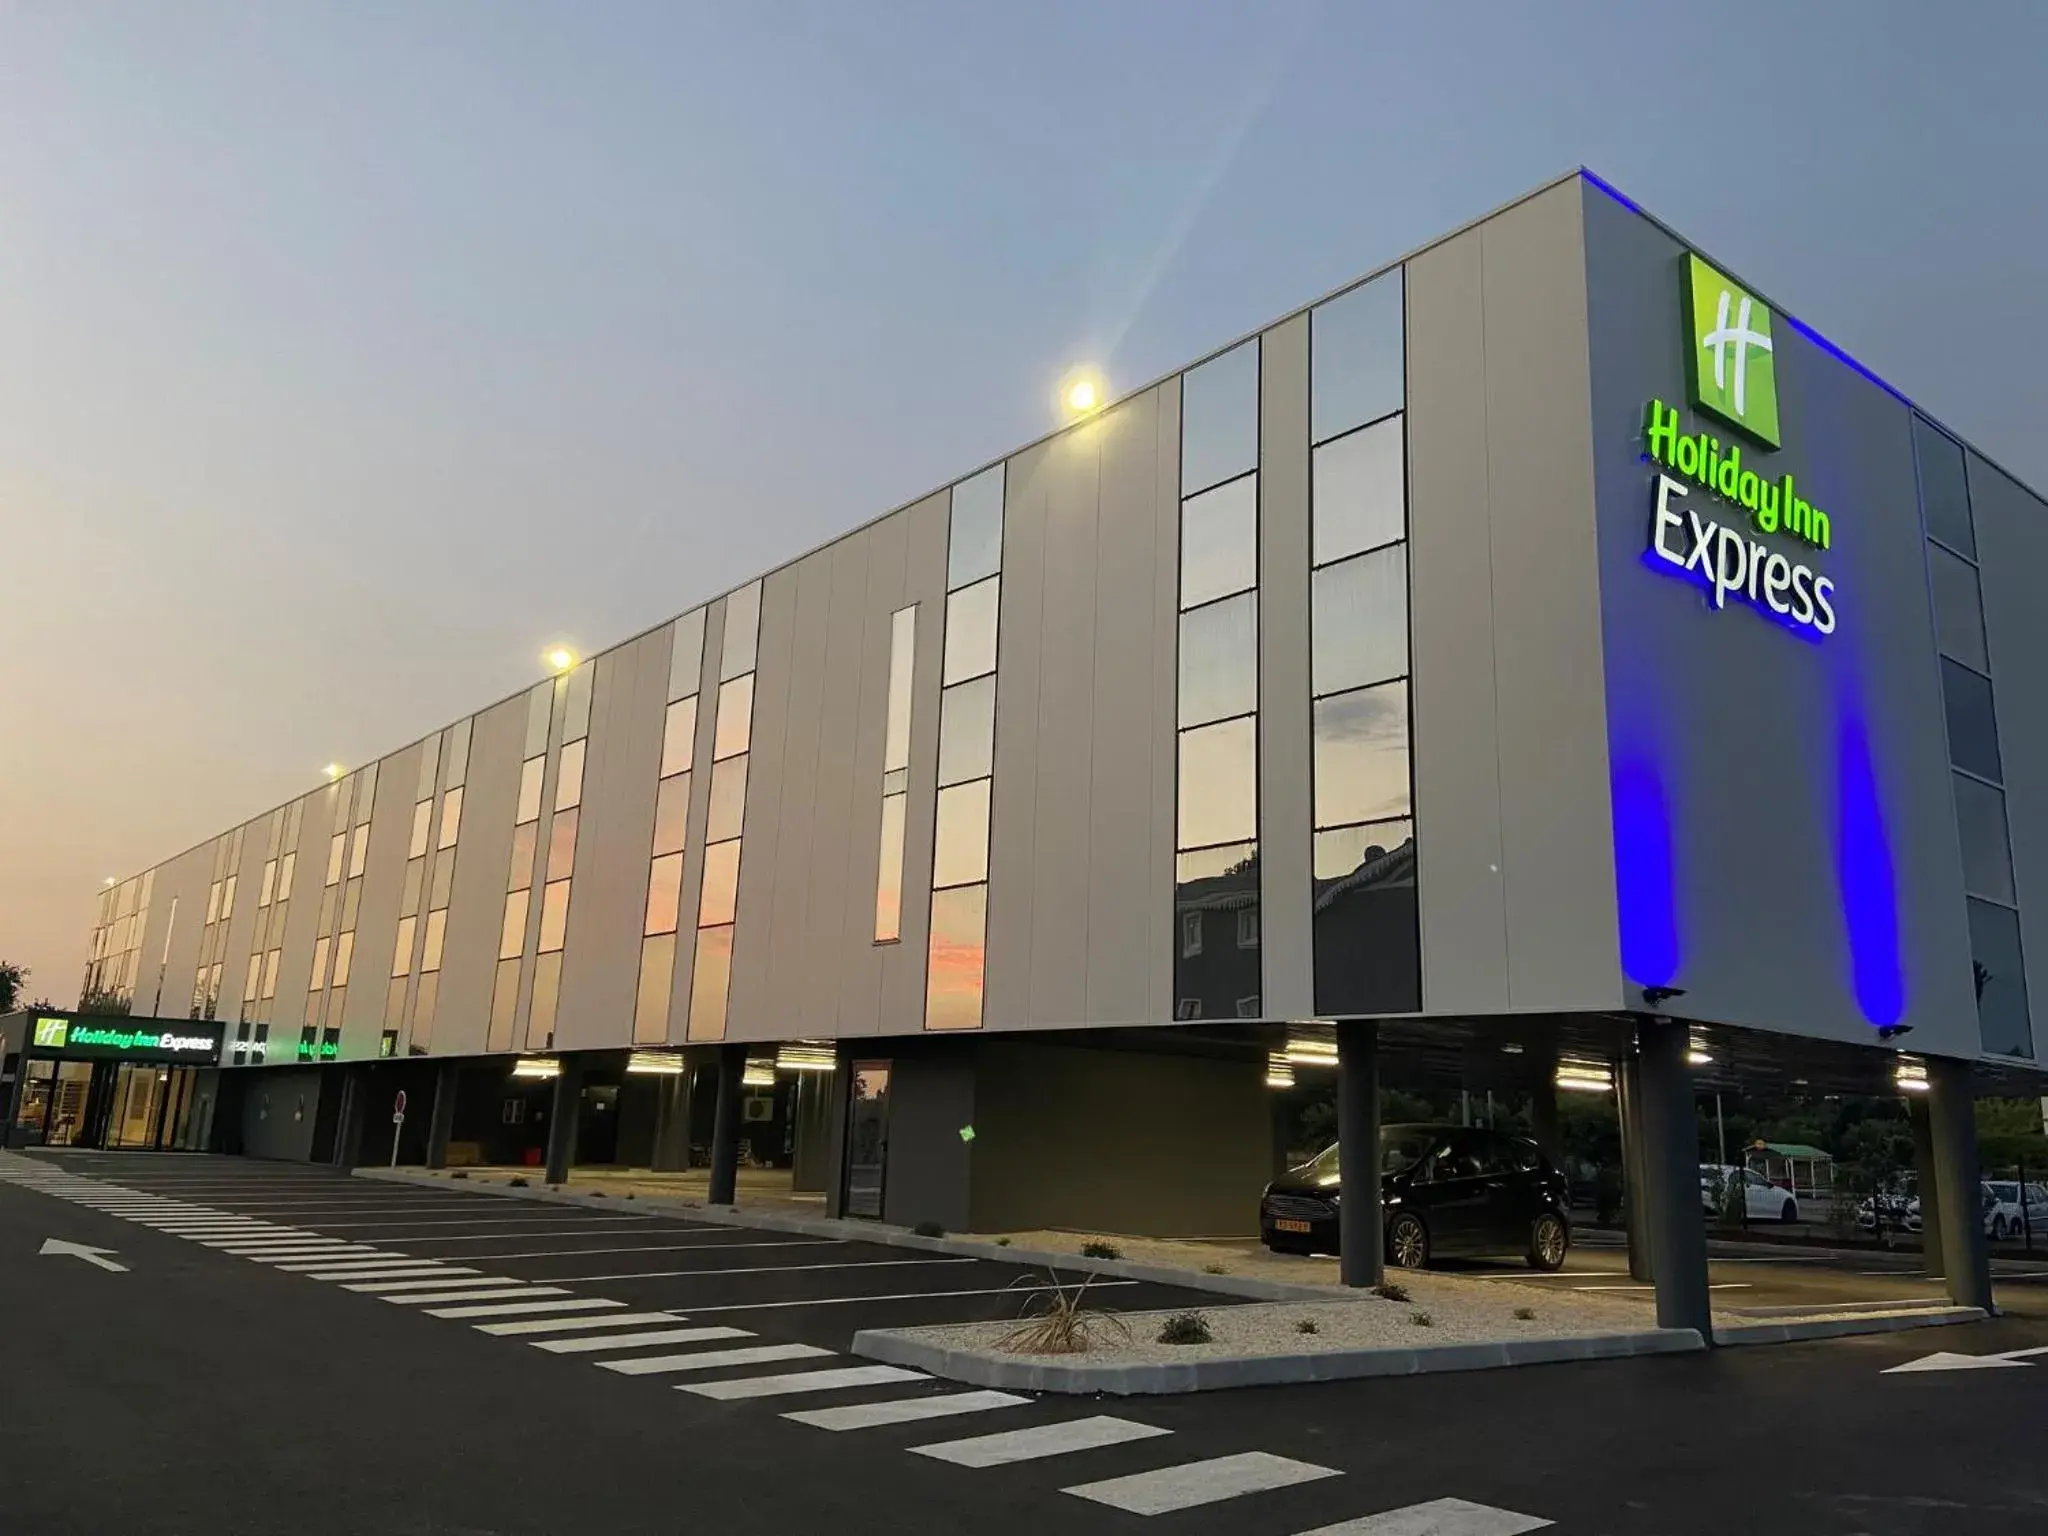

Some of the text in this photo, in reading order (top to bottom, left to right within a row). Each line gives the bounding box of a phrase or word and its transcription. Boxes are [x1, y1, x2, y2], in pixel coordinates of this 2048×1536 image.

[1648, 399, 1831, 549] Holiday Inn
[1655, 473, 1836, 635] Express
[160, 1034, 214, 1051] Express
